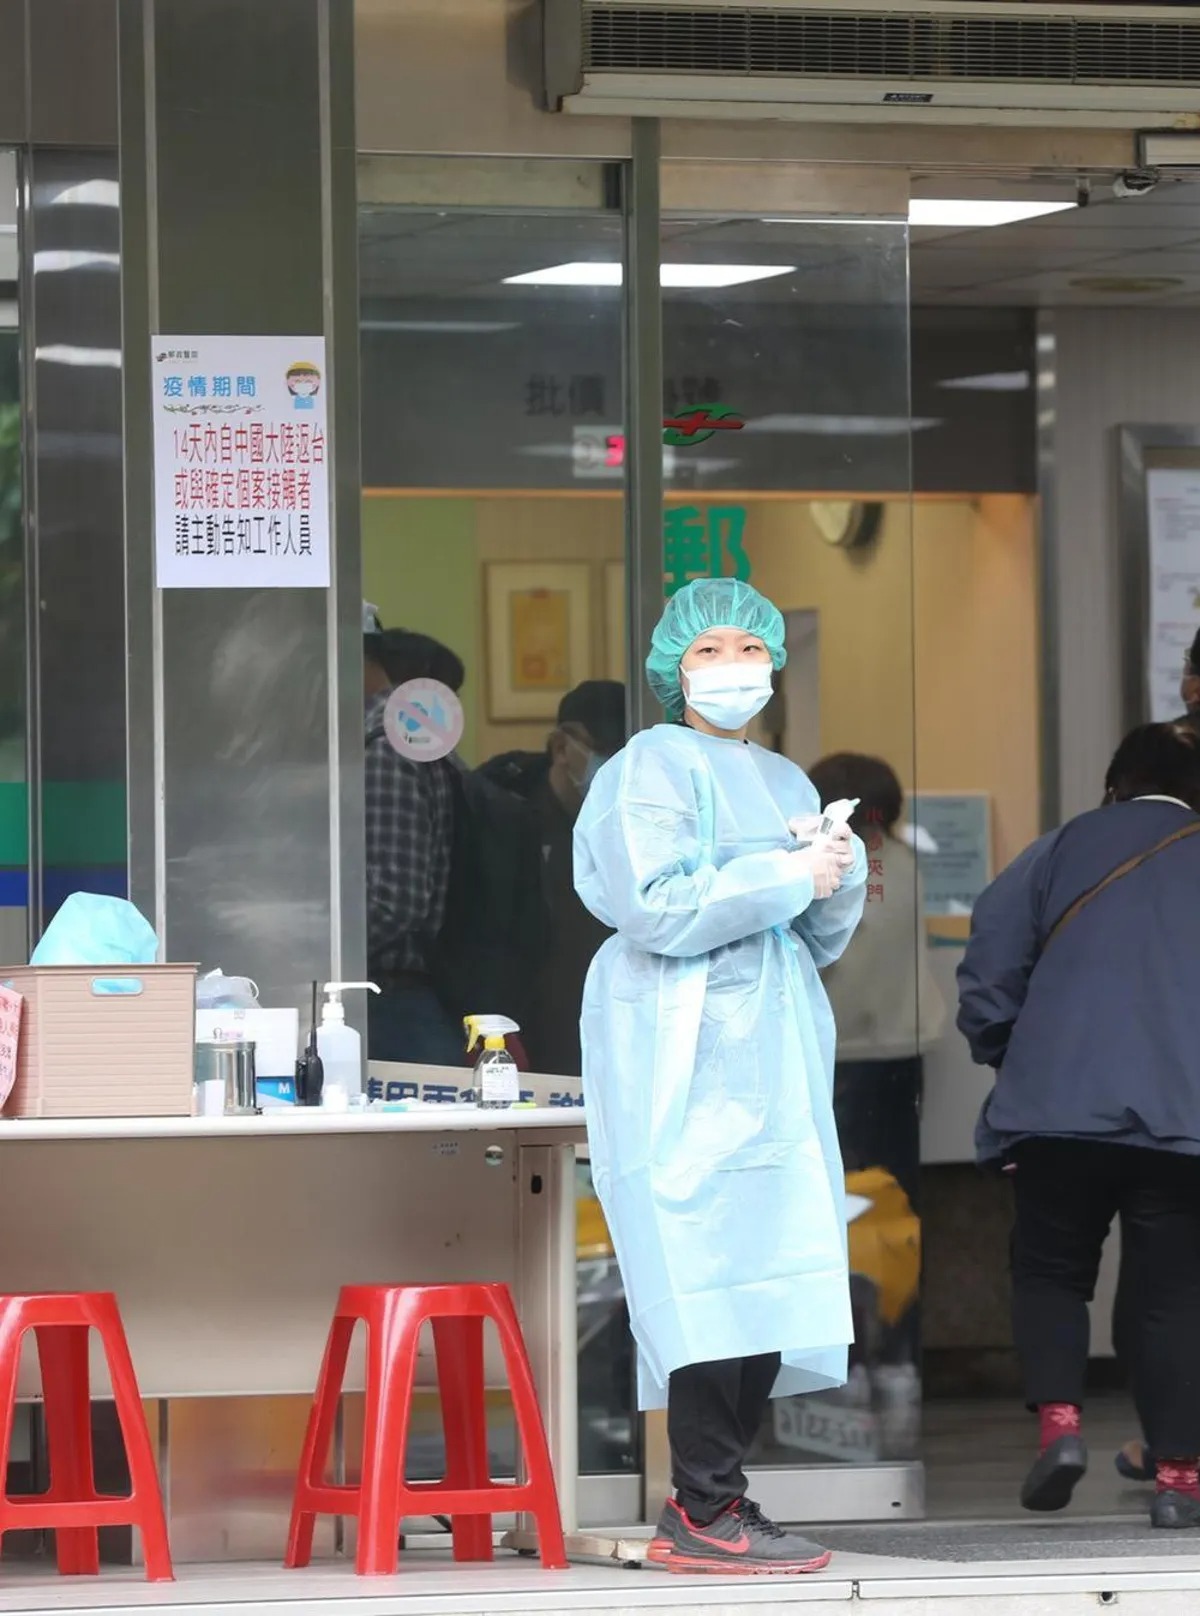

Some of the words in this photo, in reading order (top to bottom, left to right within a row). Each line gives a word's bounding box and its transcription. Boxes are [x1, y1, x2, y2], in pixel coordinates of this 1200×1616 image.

[163, 376, 256, 398] 疫情期間
[174, 468, 311, 510] 或與確定個案接觸者
[175, 514, 312, 556] 請主動告知工作人員
[278, 1082, 291, 1095] M
